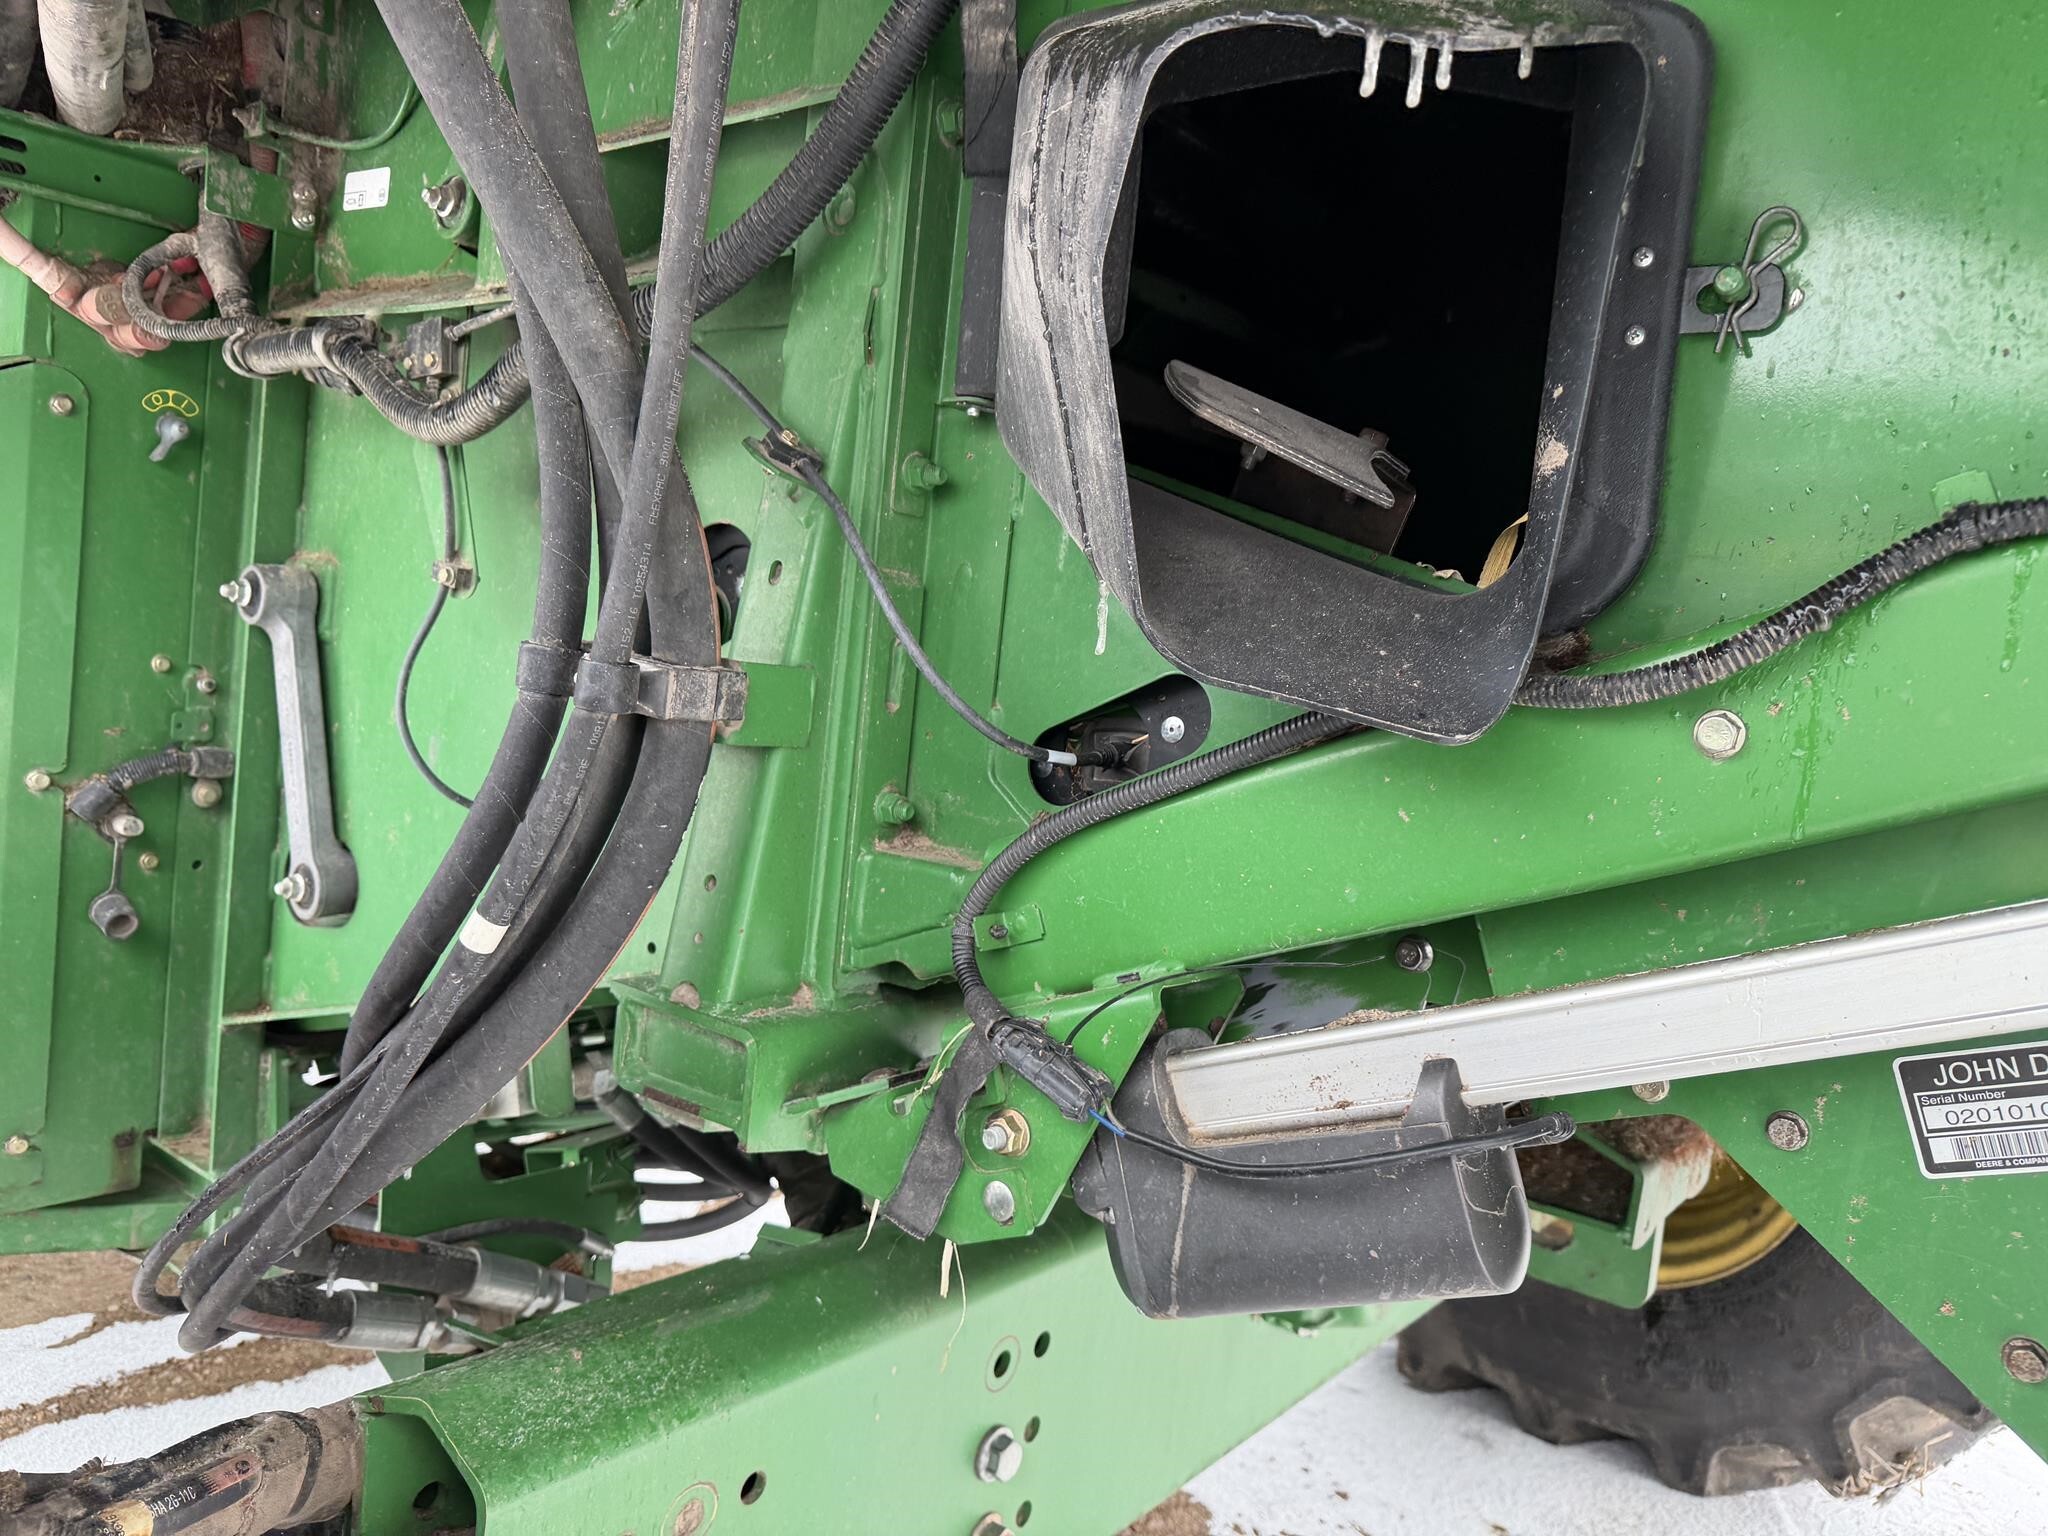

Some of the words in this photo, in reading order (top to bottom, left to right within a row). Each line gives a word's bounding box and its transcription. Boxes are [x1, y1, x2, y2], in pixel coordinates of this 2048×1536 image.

[616, 607, 639, 663] C-152/16
[648, 473, 666, 526] FLEXPAC
[659, 436, 673, 468] 3000
[586, 720, 606, 751] 100R1
[1933, 1056, 2020, 1086] JOHN
[2028, 1053, 2048, 1076] D
[1921, 1093, 1955, 1105] Serial
[1958, 1090, 2006, 1104] Number
[1975, 1160, 2004, 1168] DEERE
[2005, 1159, 2012, 1167] &
[2013, 1156, 2048, 1166] COMPAN
[164, 1486, 197, 1511] 2G-11C
